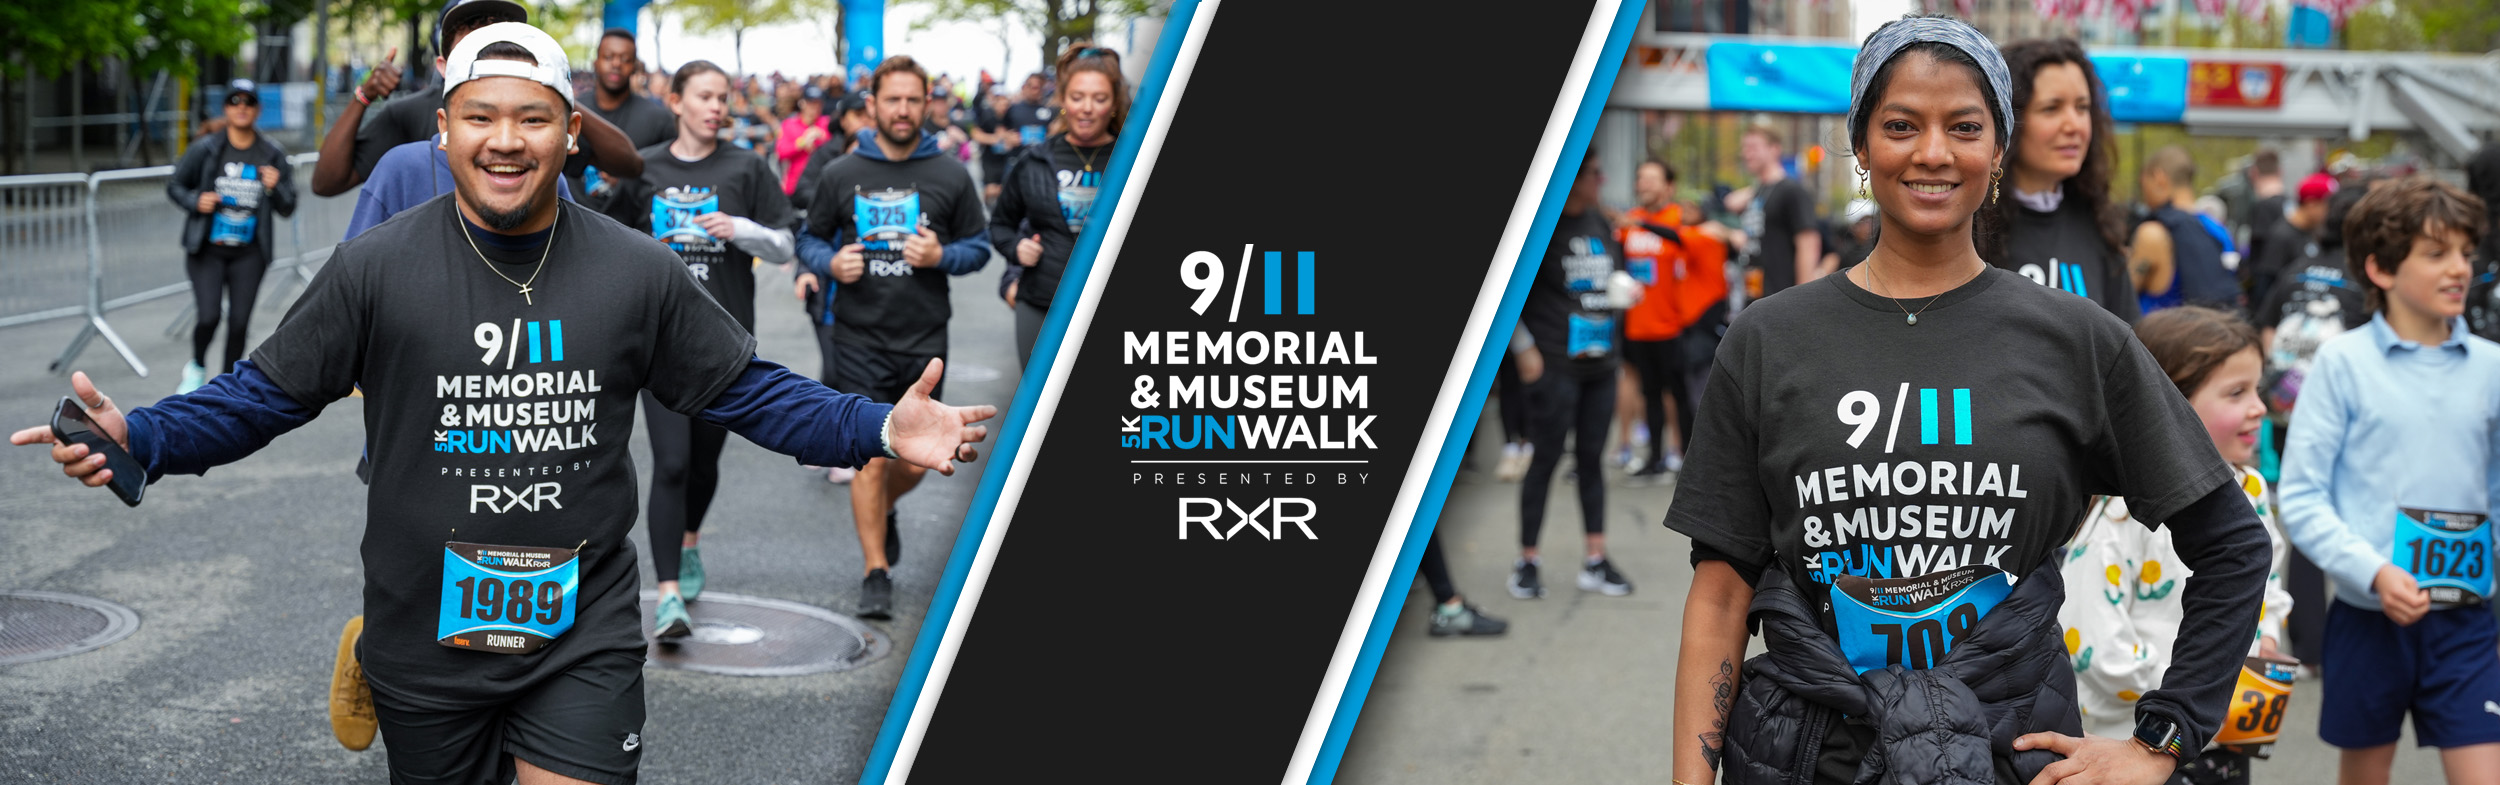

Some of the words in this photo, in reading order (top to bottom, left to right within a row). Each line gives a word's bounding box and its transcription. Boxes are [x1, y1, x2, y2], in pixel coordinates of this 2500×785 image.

[1057, 169, 1102, 188] 9/11
[666, 207, 703, 229] 32
[868, 205, 906, 226] 325
[474, 318, 564, 370] 9/11
[436, 369, 602, 399] MEMORIAL
[440, 403, 461, 427] &
[466, 398, 596, 428] MUSEUM
[1837, 382, 1973, 453] 9/11
[434, 429, 448, 453] 5K
[441, 465, 563, 477] PRESENTED
[573, 460, 592, 472] BY
[469, 481, 563, 514] RXR
[1795, 461, 2028, 508] MEMORIAL
[1803, 515, 1833, 548] &
[1832, 505, 2016, 546] MUSEUM
[487, 550, 520, 558] MEMORIAL
[533, 560, 551, 568] RXR
[1803, 552, 1825, 584] 5K
[2407, 537, 2484, 578] 1623
[1869, 586, 1884, 595] 9/11
[1884, 580, 1932, 594] MEMORIAL
[1941, 568, 1976, 584] MUSEUM
[1950, 575, 1974, 590] RXR
[455, 576, 564, 626] 1989
[486, 633, 526, 649] RUNNER
[1870, 602, 1979, 671] 708
